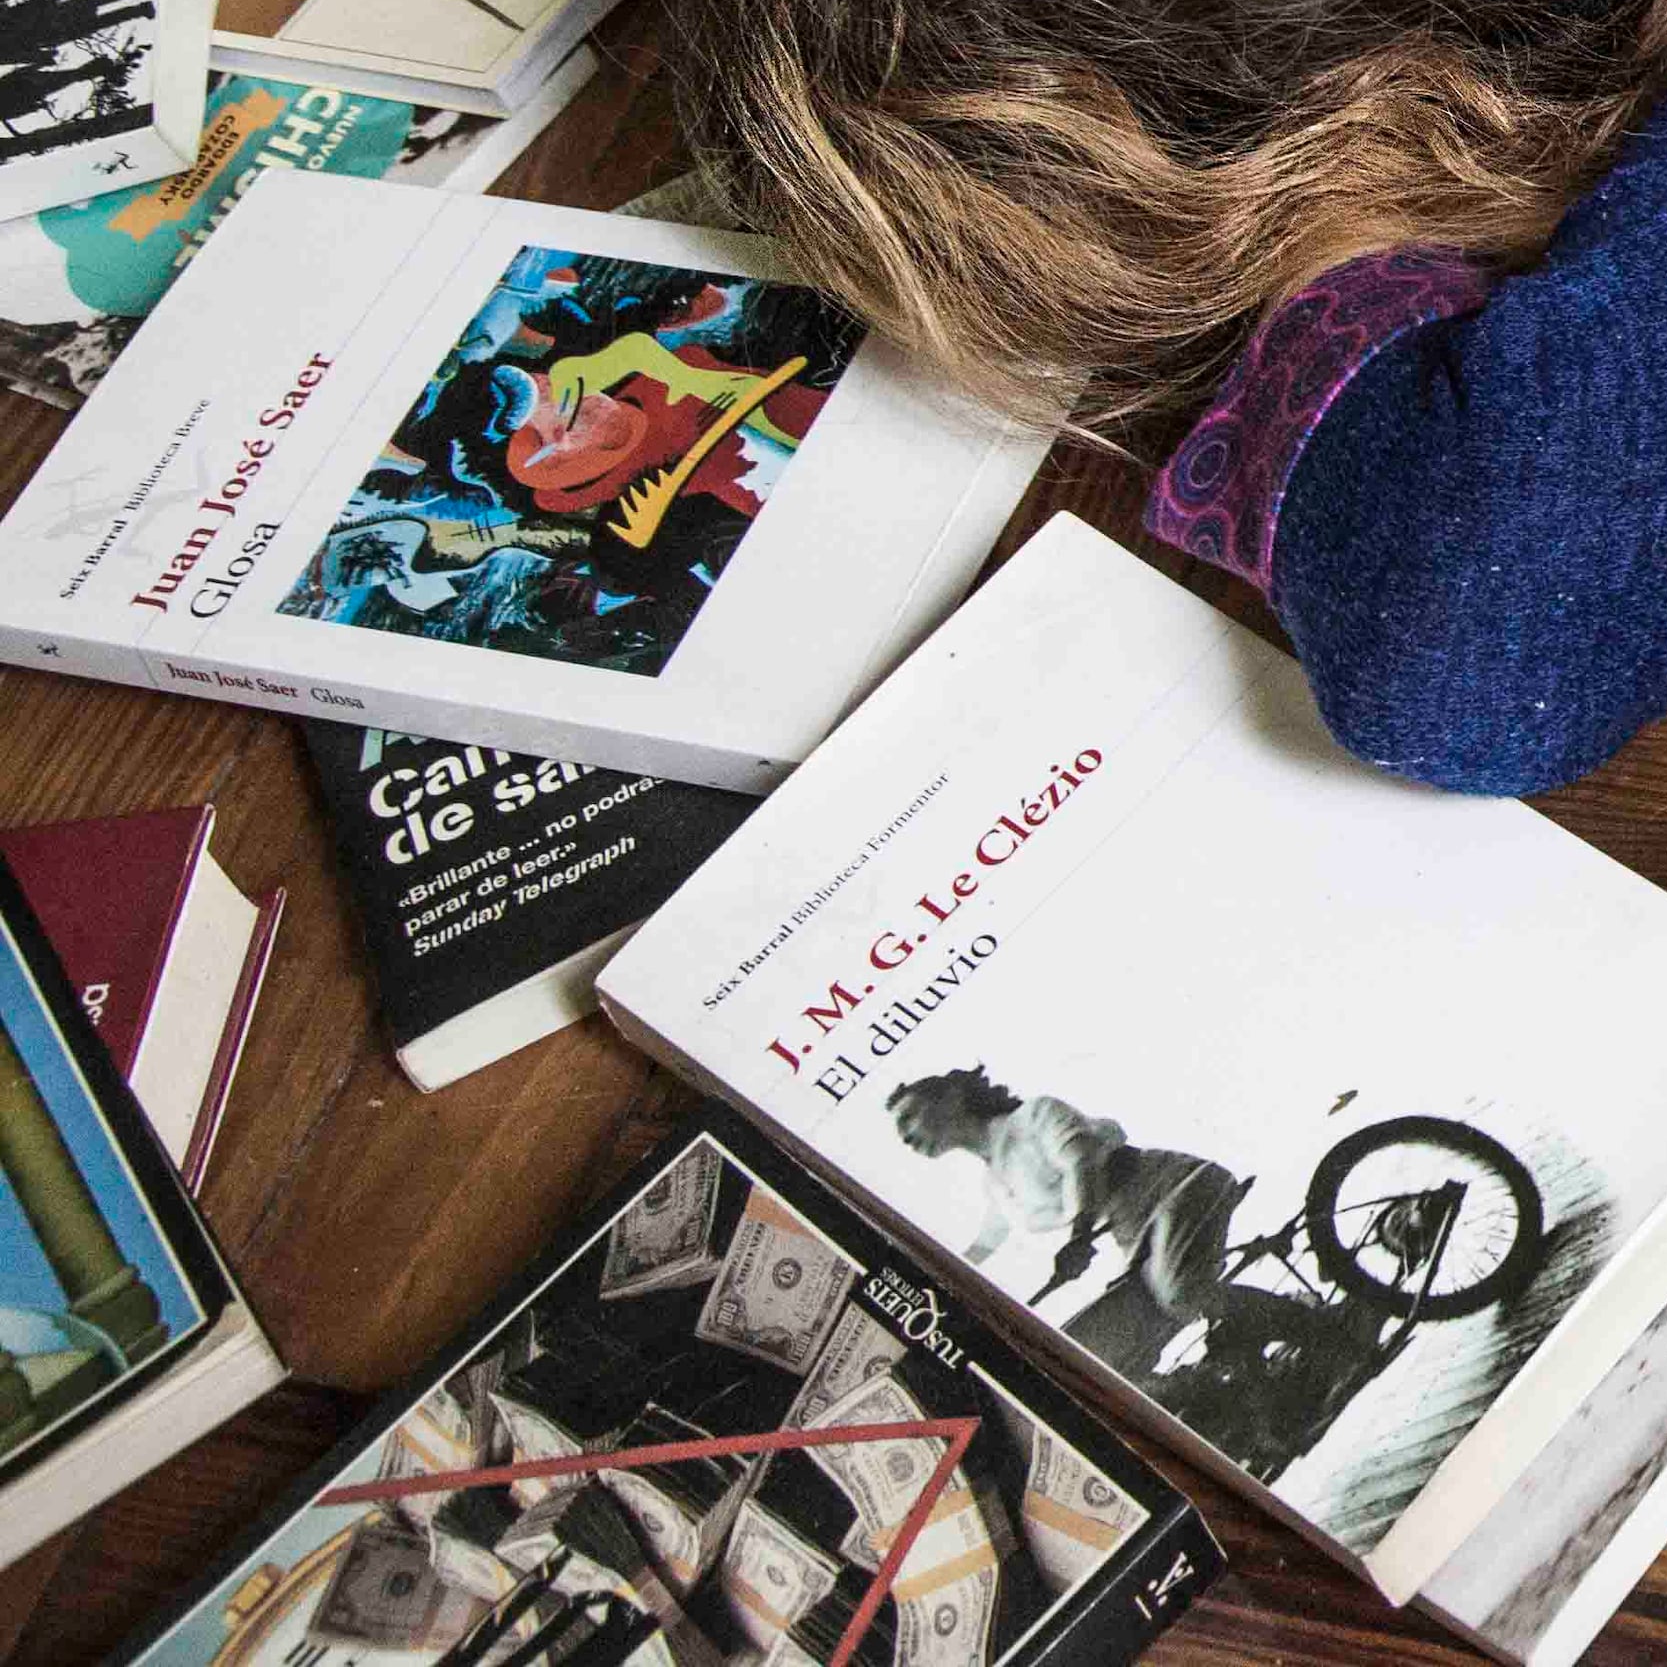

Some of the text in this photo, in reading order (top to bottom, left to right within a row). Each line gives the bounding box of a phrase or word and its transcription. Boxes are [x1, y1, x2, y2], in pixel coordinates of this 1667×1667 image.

[170, 131, 240, 200] EDGARDO
[307, 104, 362, 170] NUEVO
[60, 398, 211, 600] Seix Barral Biblioteca Breve
[130, 352, 333, 614] Juan José Saer
[190, 520, 282, 619] Glosa
[166, 663, 365, 710] Juan José Saer Glosa
[385, 801, 474, 864] de
[398, 841, 511, 908] «Brillante
[545, 813, 578, 838] no
[404, 841, 578, 936] parar de leer.»
[413, 836, 636, 956] Sunday Telegraph
[702, 771, 951, 1012] Seix Barral Biblioteca Formentor
[765, 747, 1103, 1075] J. M. G. Le Clézio
[813, 932, 1000, 1105] El diluvio
[863, 1277, 966, 1370] TUSQUETS
